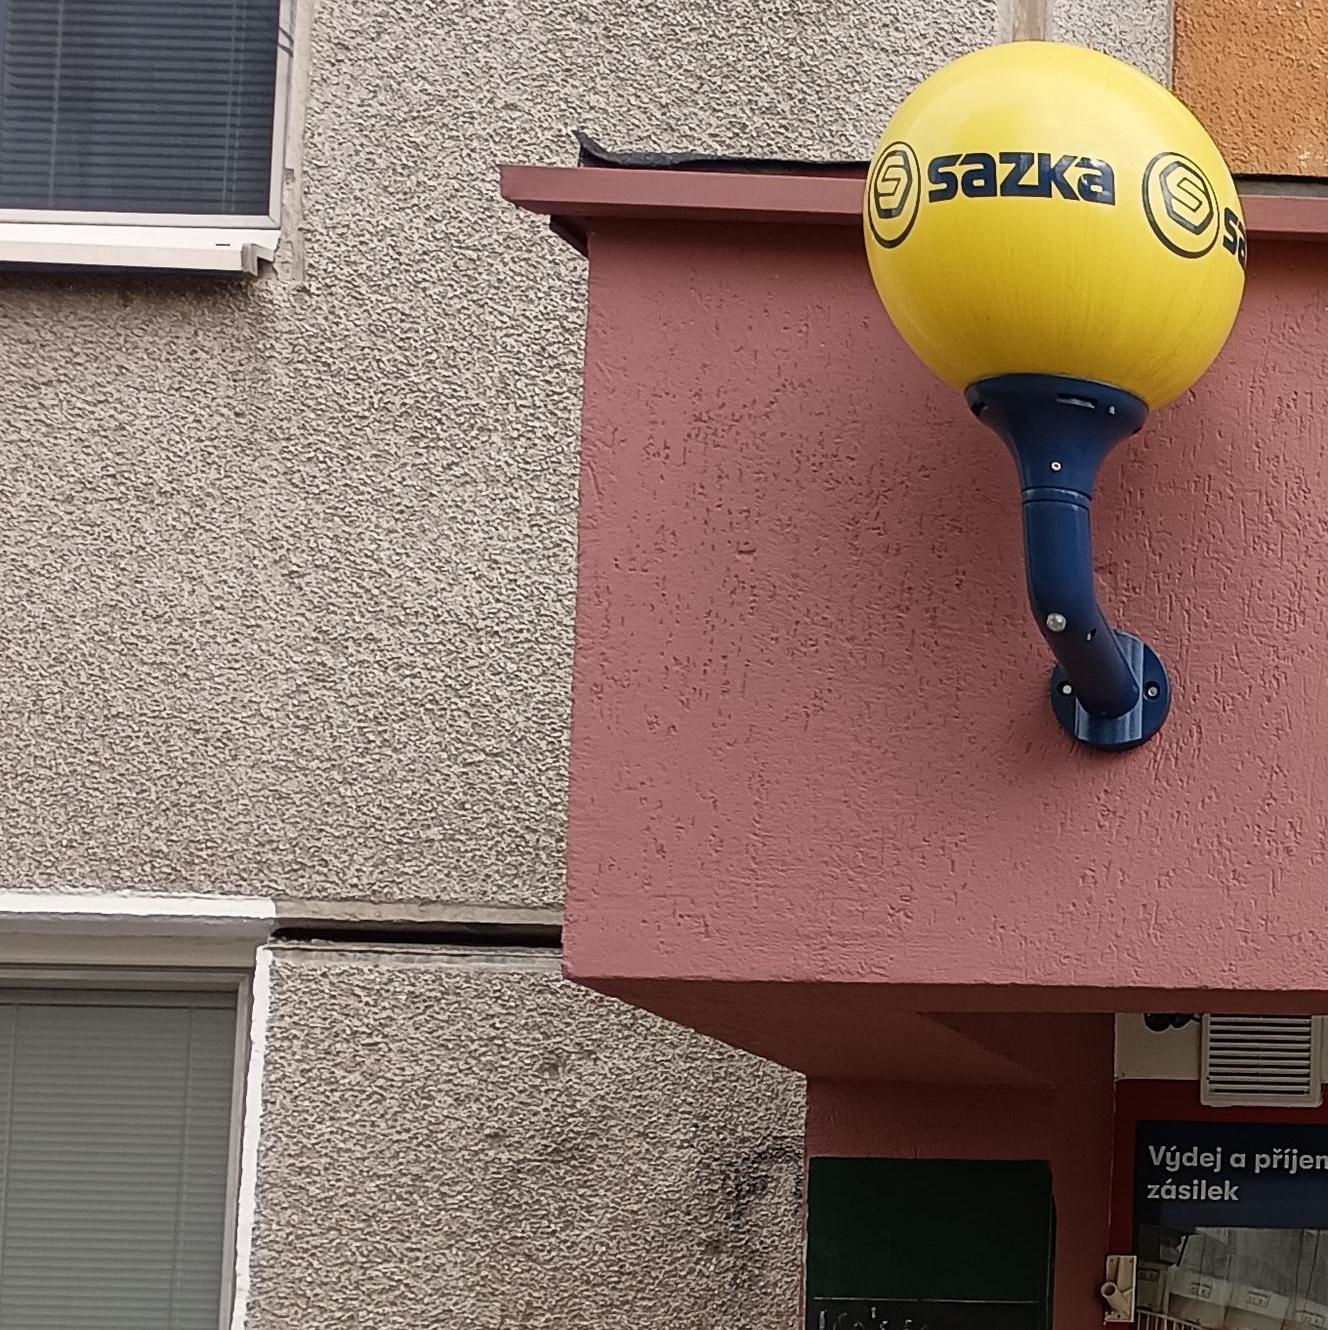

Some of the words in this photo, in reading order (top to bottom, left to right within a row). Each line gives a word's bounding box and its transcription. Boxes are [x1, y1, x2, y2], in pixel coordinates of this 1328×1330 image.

[1148, 1145, 1222, 1172] Výdej
[1230, 1152, 1246, 1168] a
[1147, 1178, 1240, 1200] zásilek
